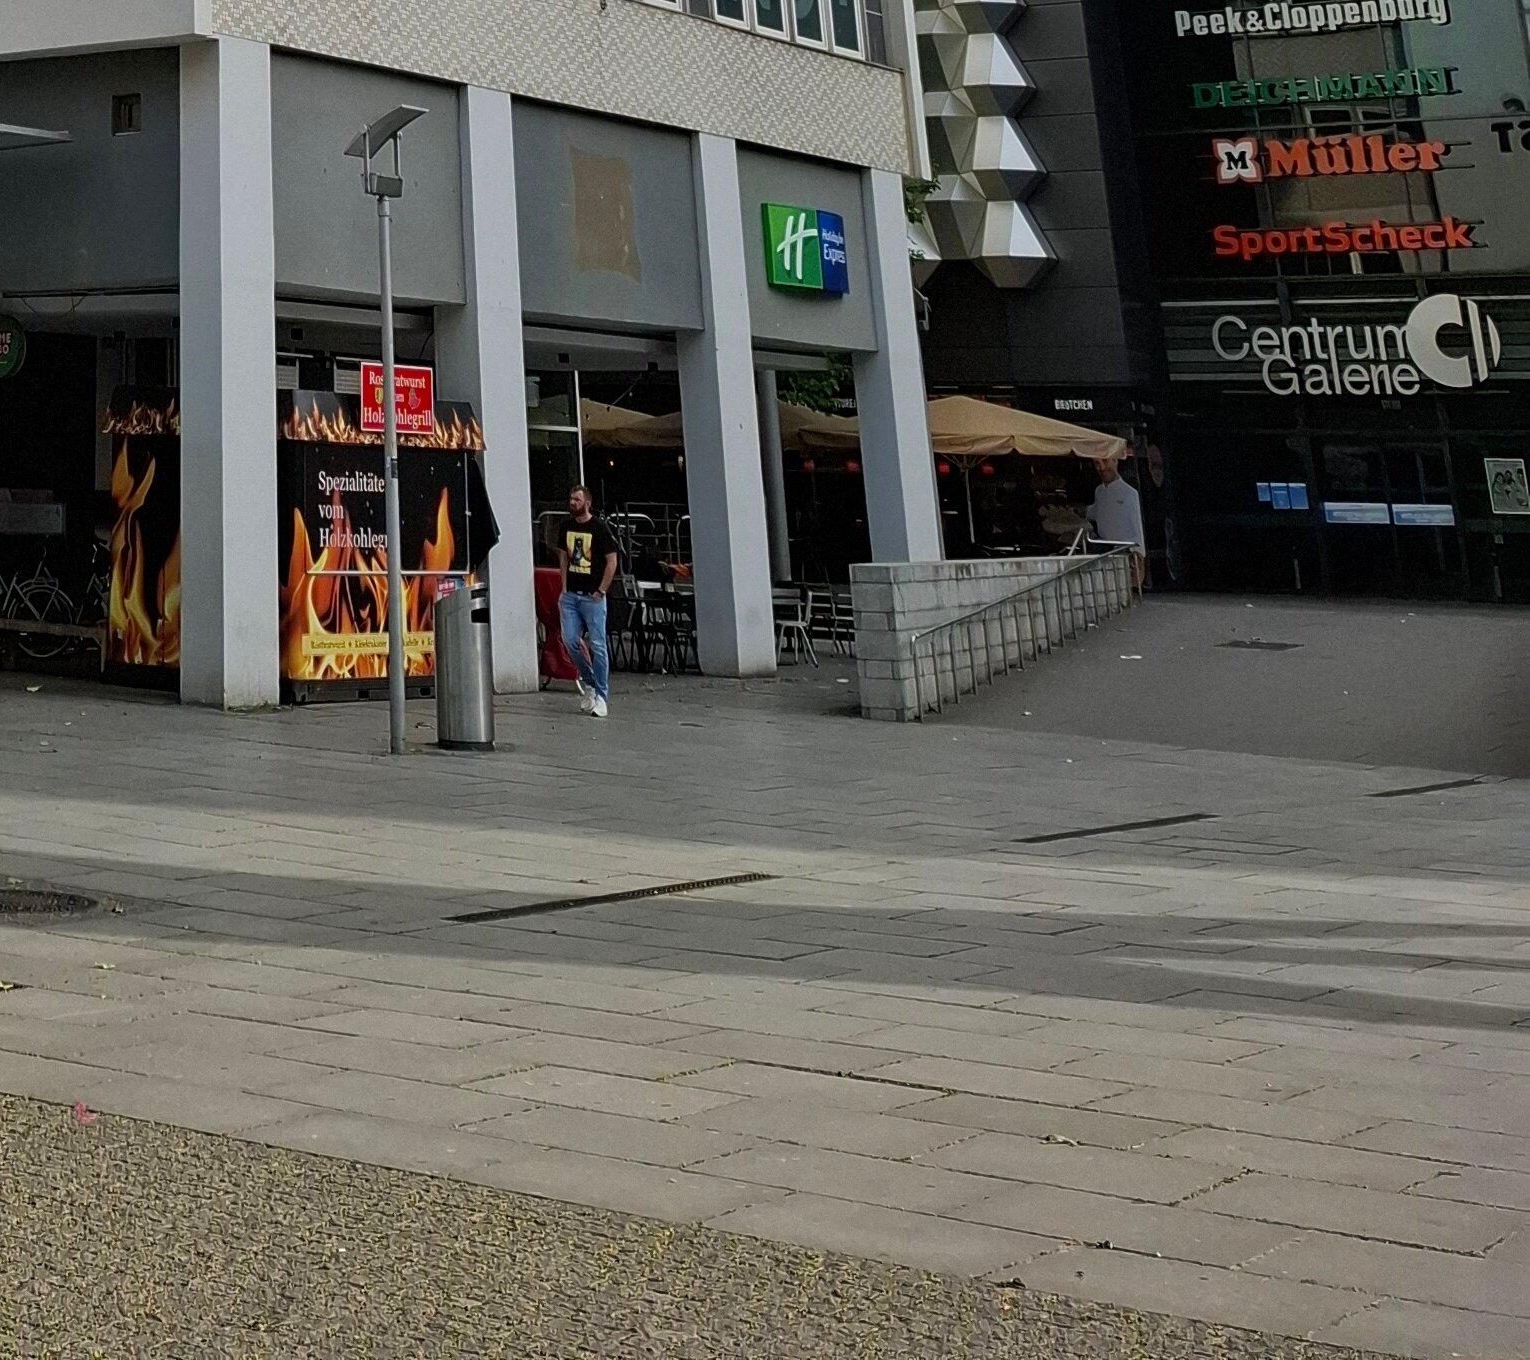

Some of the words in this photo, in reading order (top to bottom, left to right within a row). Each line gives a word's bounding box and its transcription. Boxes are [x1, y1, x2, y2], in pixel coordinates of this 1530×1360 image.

[1191, 67, 1452, 108] DEICHMANN
[1265, 134, 1447, 178] Müller
[1213, 217, 1473, 260] SportScheck
[1211, 315, 1408, 361] Centrum
[1262, 351, 1421, 396] Galerie
[318, 470, 385, 496] Spezialitäte
[318, 504, 345, 520] vom
